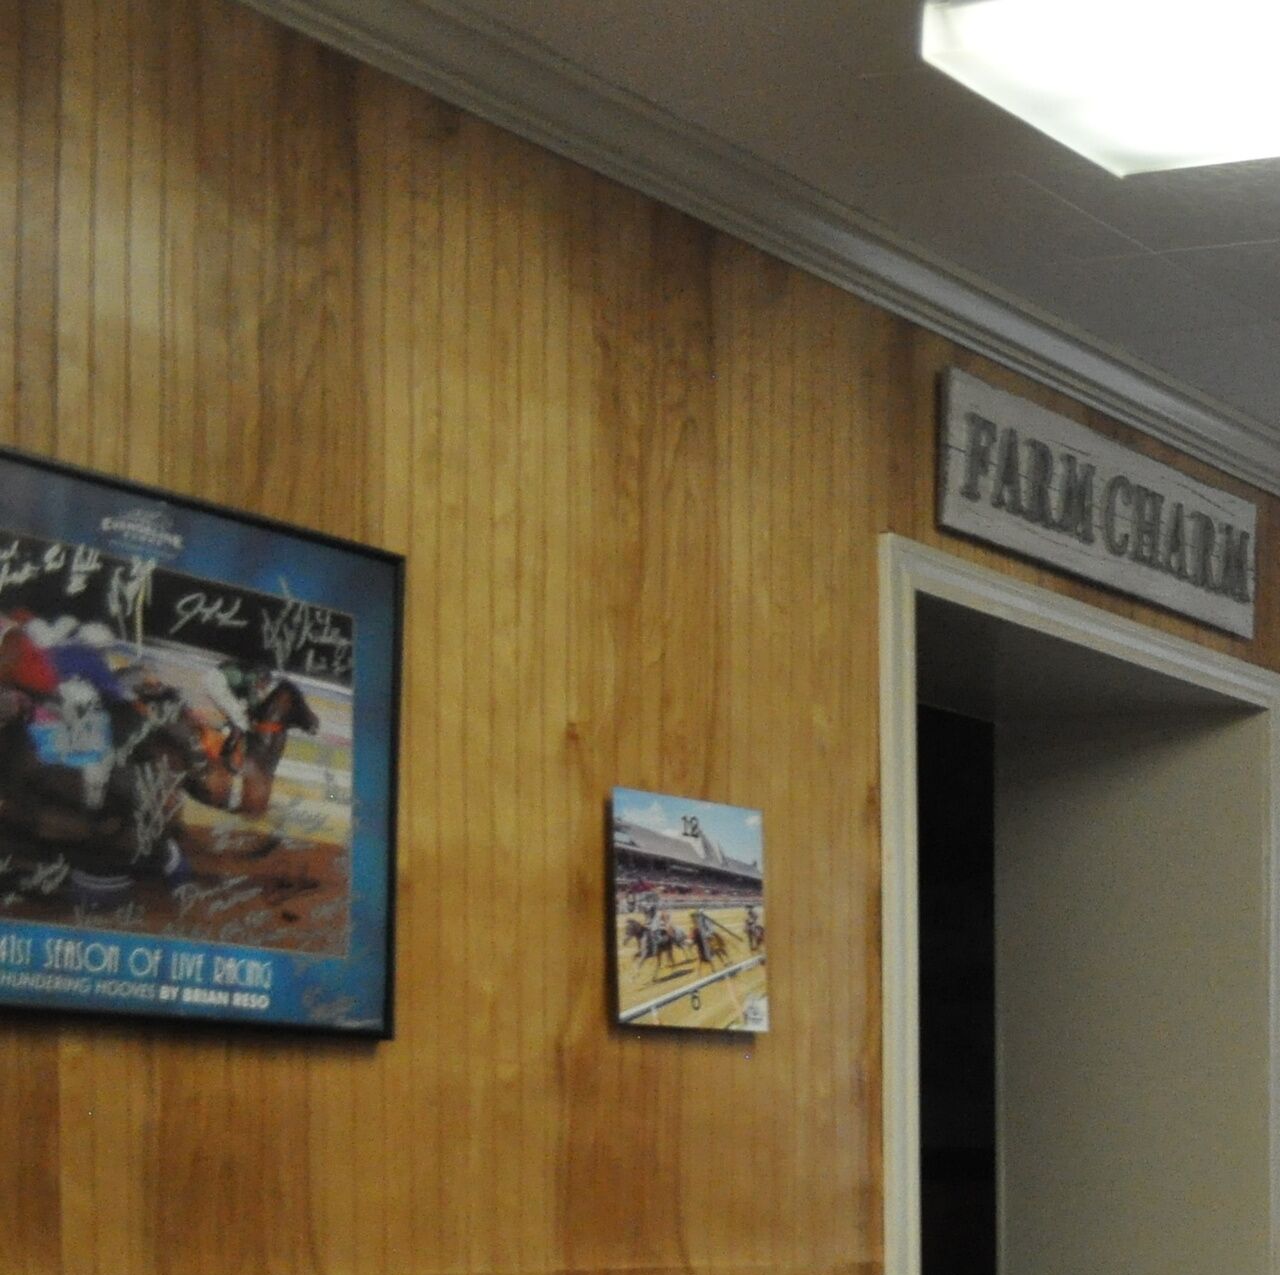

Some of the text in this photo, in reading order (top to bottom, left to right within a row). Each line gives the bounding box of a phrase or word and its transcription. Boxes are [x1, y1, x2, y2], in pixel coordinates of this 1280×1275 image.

[959, 412, 1251, 603] FARM CHARM
[43, 938, 120, 974] SEASON
[170, 951, 206, 983] LIVE
[213, 956, 272, 989] RACING
[159, 984, 179, 1001] BY
[182, 987, 229, 1006] BRIAN
[232, 991, 271, 1010] RESO
